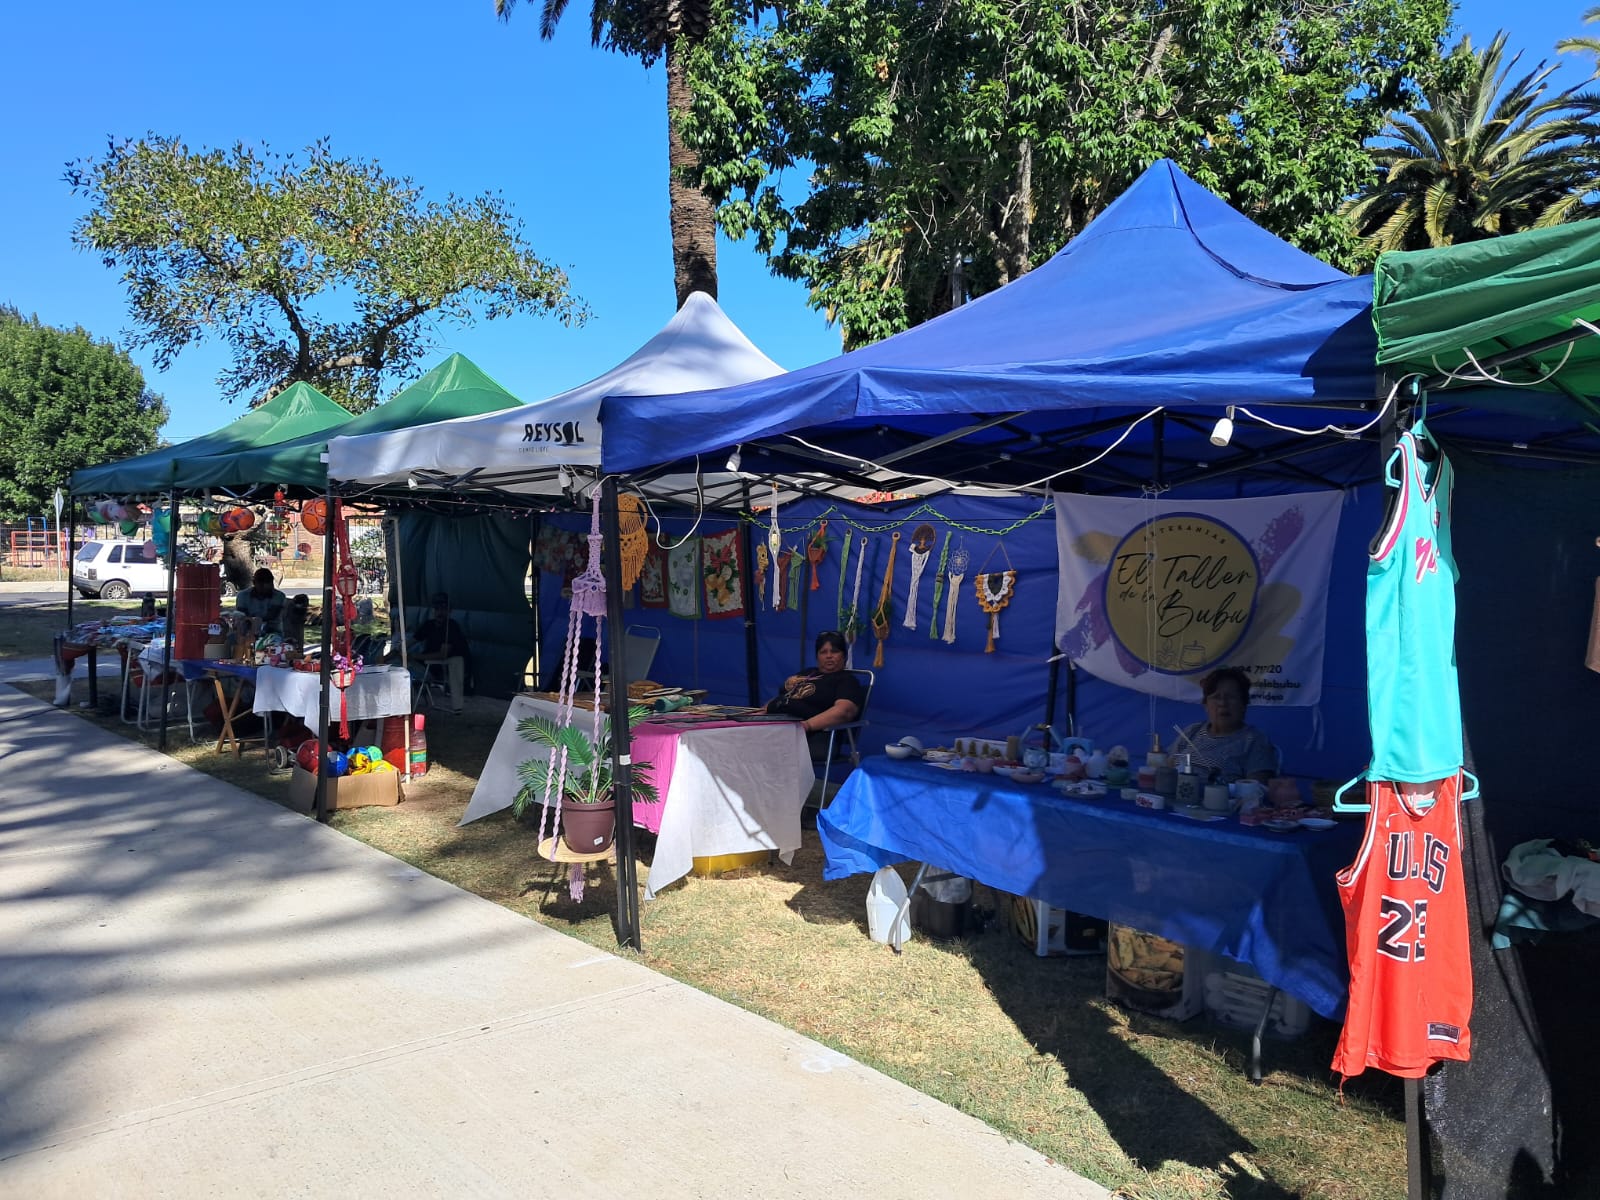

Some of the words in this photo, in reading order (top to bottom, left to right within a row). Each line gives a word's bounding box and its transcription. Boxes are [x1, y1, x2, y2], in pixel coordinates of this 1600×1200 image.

[522, 421, 585, 444] REYSOL
[1117, 553, 1154, 585] El
[1162, 555, 1252, 590] Taller
[1157, 589, 1249, 638] Bubu
